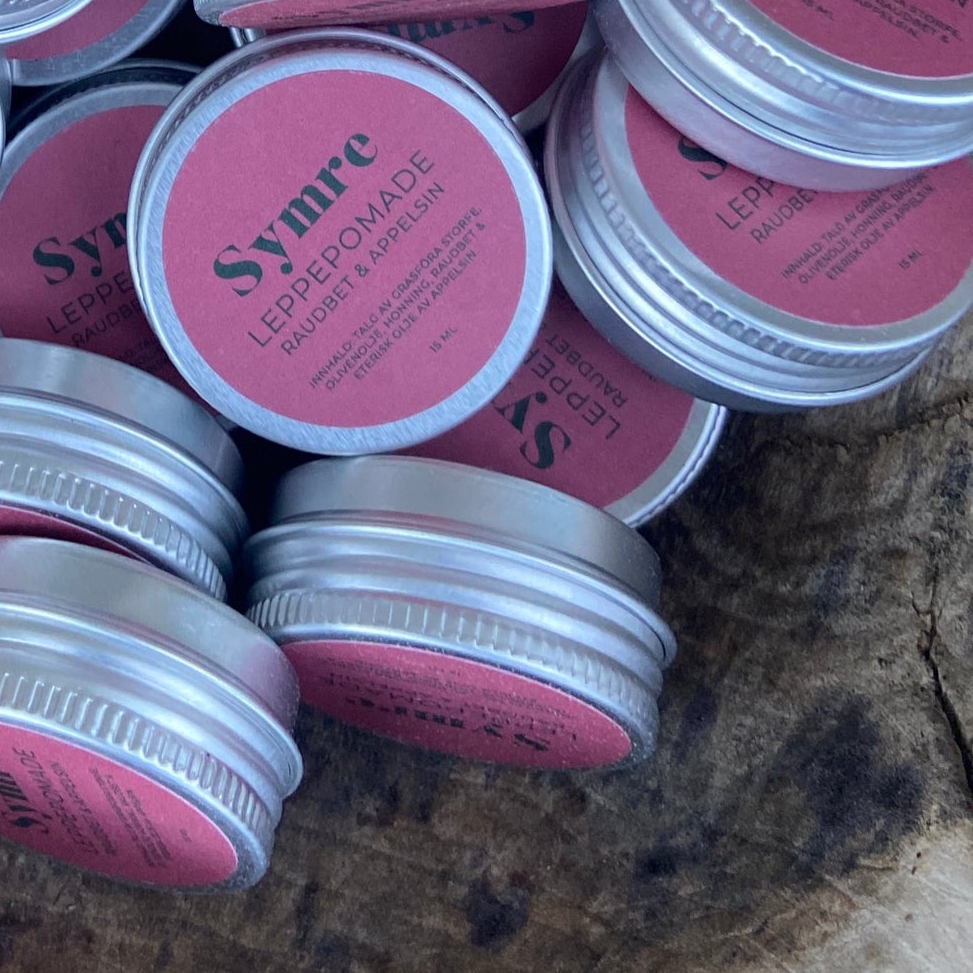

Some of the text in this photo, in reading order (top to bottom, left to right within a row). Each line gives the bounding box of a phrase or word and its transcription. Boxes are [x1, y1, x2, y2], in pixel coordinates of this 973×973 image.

[213, 133, 378, 298] Symre
[246, 148, 435, 348] LEPPEPOMADE
[430, 227, 477, 279] RAUDBET
[475, 221, 487, 231] &
[749, 180, 818, 244] RAUDBE
[279, 181, 445, 357] RAUDBET & APPELSIN
[307, 339, 355, 390] INNHALD:
[351, 312, 379, 340] TALG
[378, 297, 392, 316] AV
[353, 337, 395, 382] ETERISK
[391, 312, 419, 340] OLJE
[416, 297, 431, 315] AV
[428, 326, 459, 354] 15 ML
[546, 333, 627, 408] RAUDBET
